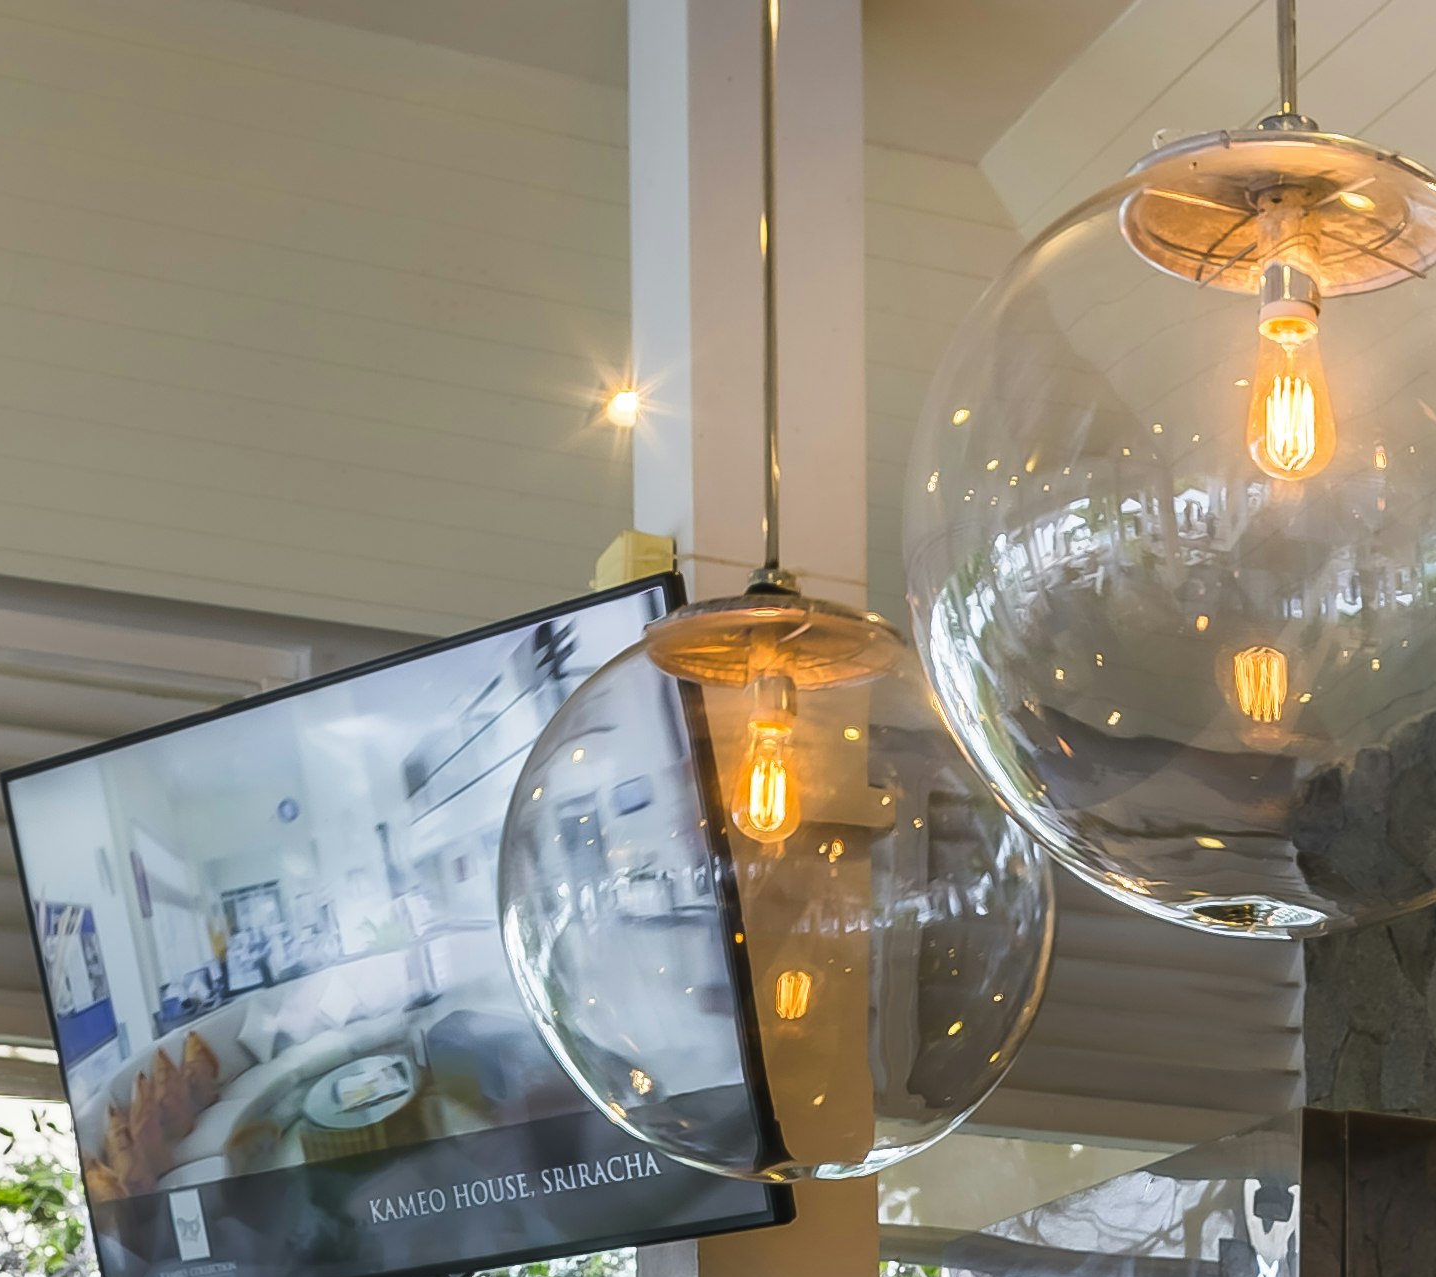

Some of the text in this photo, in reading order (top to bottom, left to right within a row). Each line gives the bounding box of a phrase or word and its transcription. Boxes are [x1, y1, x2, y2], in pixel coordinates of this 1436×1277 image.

[368, 1151, 662, 1224] KAMEO HOUSE, SRIRACHA
